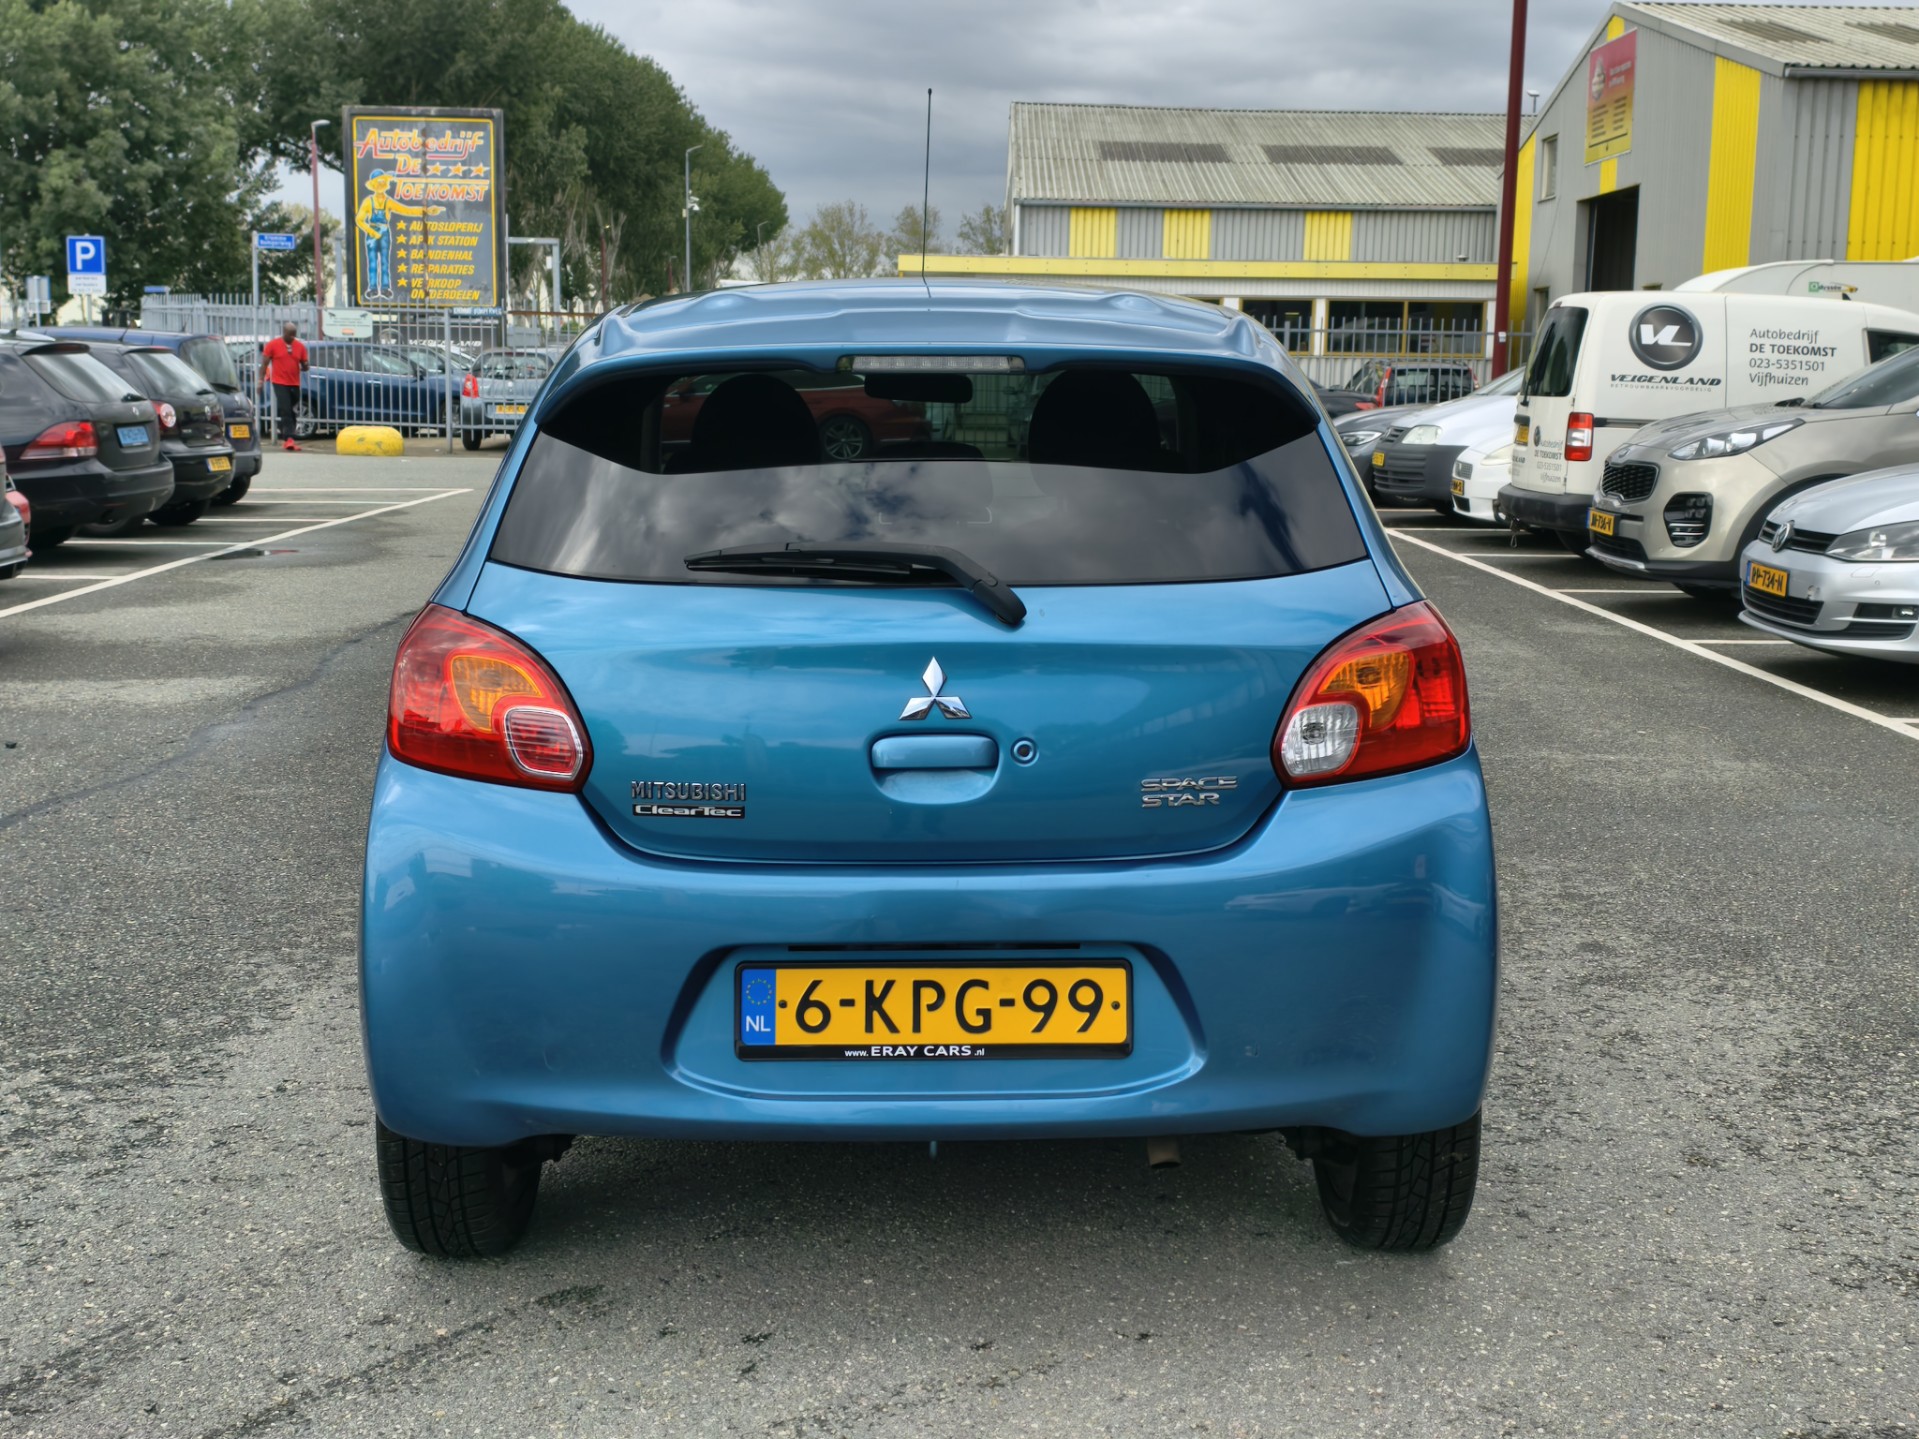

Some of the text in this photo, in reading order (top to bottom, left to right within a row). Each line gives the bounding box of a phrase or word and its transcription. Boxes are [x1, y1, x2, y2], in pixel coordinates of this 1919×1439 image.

[354, 127, 484, 160] Autobedrijf
[437, 235, 479, 248] STATION
[75, 241, 96, 270] P
[410, 248, 473, 261] BANDENHAL
[410, 263, 475, 276] REPARATIES
[411, 277, 462, 289] VERKOOP
[411, 288, 480, 301] ONDERDELEN
[1749, 328, 1820, 345] Autobedrijf
[1749, 342, 1837, 358] DE TOEKOMST
[1749, 357, 1826, 372] 023-5351501
[1610, 374, 1722, 386] VEIGENLAND
[1749, 371, 1810, 387] Vijfhuizen
[630, 780, 746, 801] MITSUBISHI
[1140, 775, 1238, 792] SPACE
[1141, 792, 1220, 808] STAR
[635, 804, 742, 817] ClearTec
[795, 978, 1105, 1034] 6-KPG-99
[745, 1015, 772, 1032] NL
[871, 1045, 918, 1057] ERAY
[923, 1045, 972, 1057] CARS
